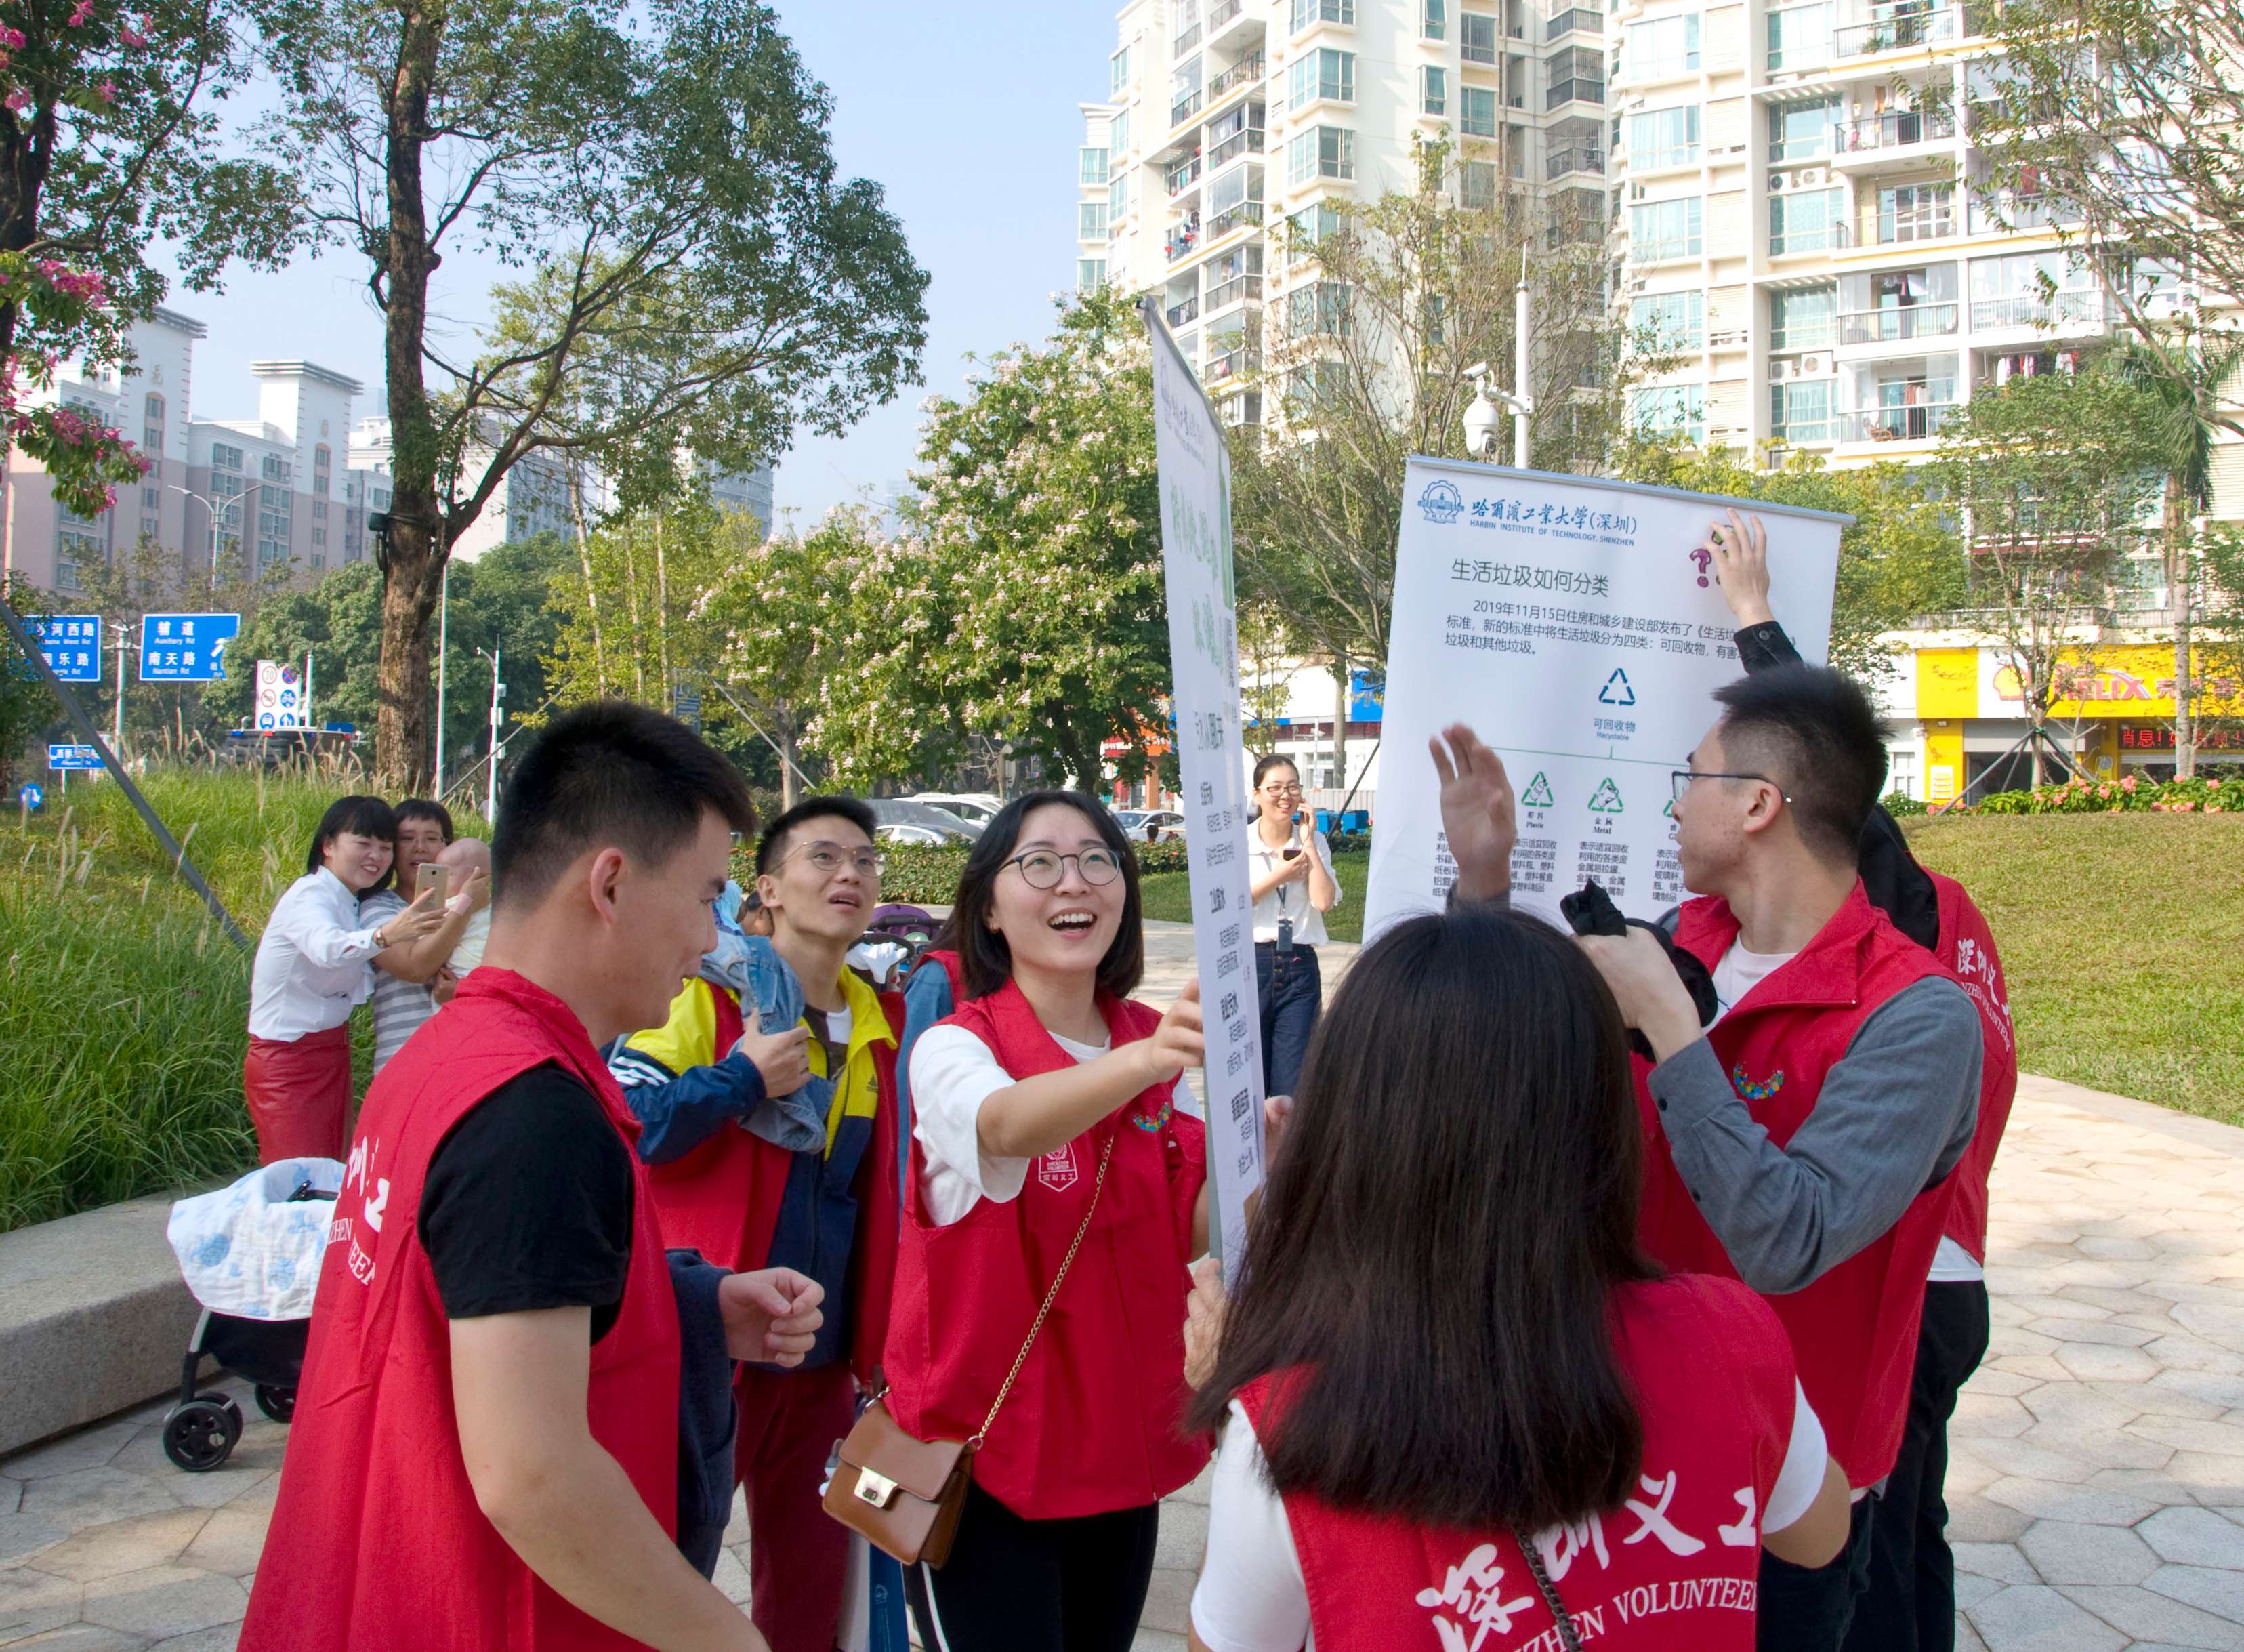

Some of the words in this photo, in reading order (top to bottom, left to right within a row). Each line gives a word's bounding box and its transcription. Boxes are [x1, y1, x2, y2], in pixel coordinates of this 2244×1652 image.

[1470, 520, 1496, 529] HARBIN
[1500, 523, 1535, 535] INSTITUTE
[1552, 529, 1598, 542] TECHNOLOGY,
[1600, 535, 1634, 546] SHENZHEN
[1451, 558, 1609, 598] 生活垃圾如何分类
[157, 621, 194, 636] 辅道
[154, 638, 183, 646] Auxiliary
[1445, 632, 1536, 655] 垃圾和其他垃圾。
[1446, 614, 1741, 660] 标准，新的标准中将生活垃圾分为四类：可回收物，有害
[148, 651, 195, 666] 南天路
[1593, 718, 1636, 732] 可回收物
[1596, 731, 1629, 741] Recyclable
[1594, 817, 1613, 826] 金属
[1593, 826, 1612, 835] Metal
[1580, 841, 1629, 854] 表示适宜回收
[1579, 852, 1627, 864] 利用的各类废
[1612, 1577, 1758, 1626] VOLUNTEE
